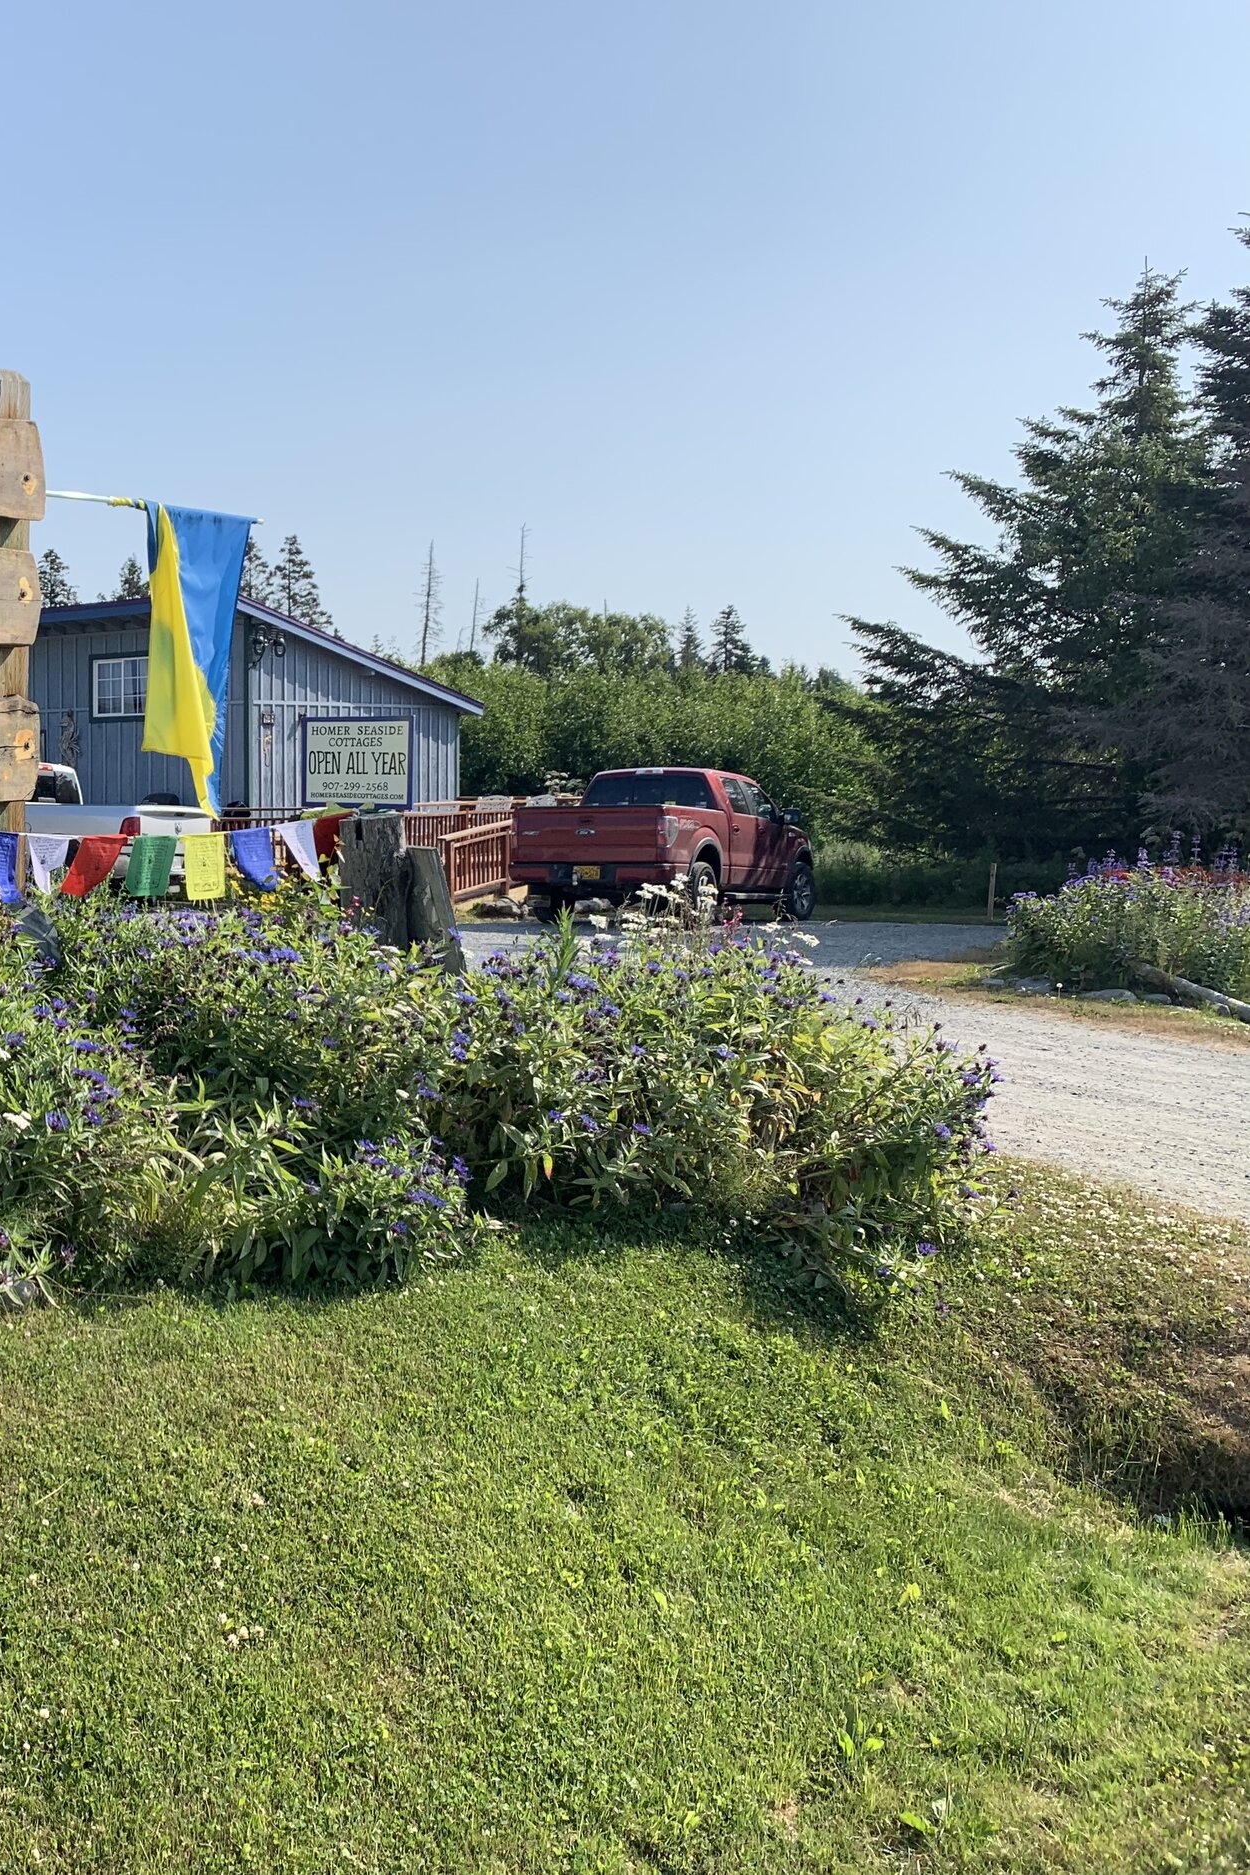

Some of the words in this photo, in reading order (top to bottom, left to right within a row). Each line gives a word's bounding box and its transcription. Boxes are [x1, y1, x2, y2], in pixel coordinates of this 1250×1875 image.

[311, 726, 350, 736] HOMER
[357, 725, 404, 736] SEASIDE
[328, 737, 383, 747] COTTAGES
[308, 750, 342, 775] OPEN
[345, 751, 369, 775] ALL
[370, 751, 407, 776] YEAR
[322, 781, 389, 792] 907-299-2568
[310, 792, 404, 800] HOMERSEASIDECOTTAGES.COM
